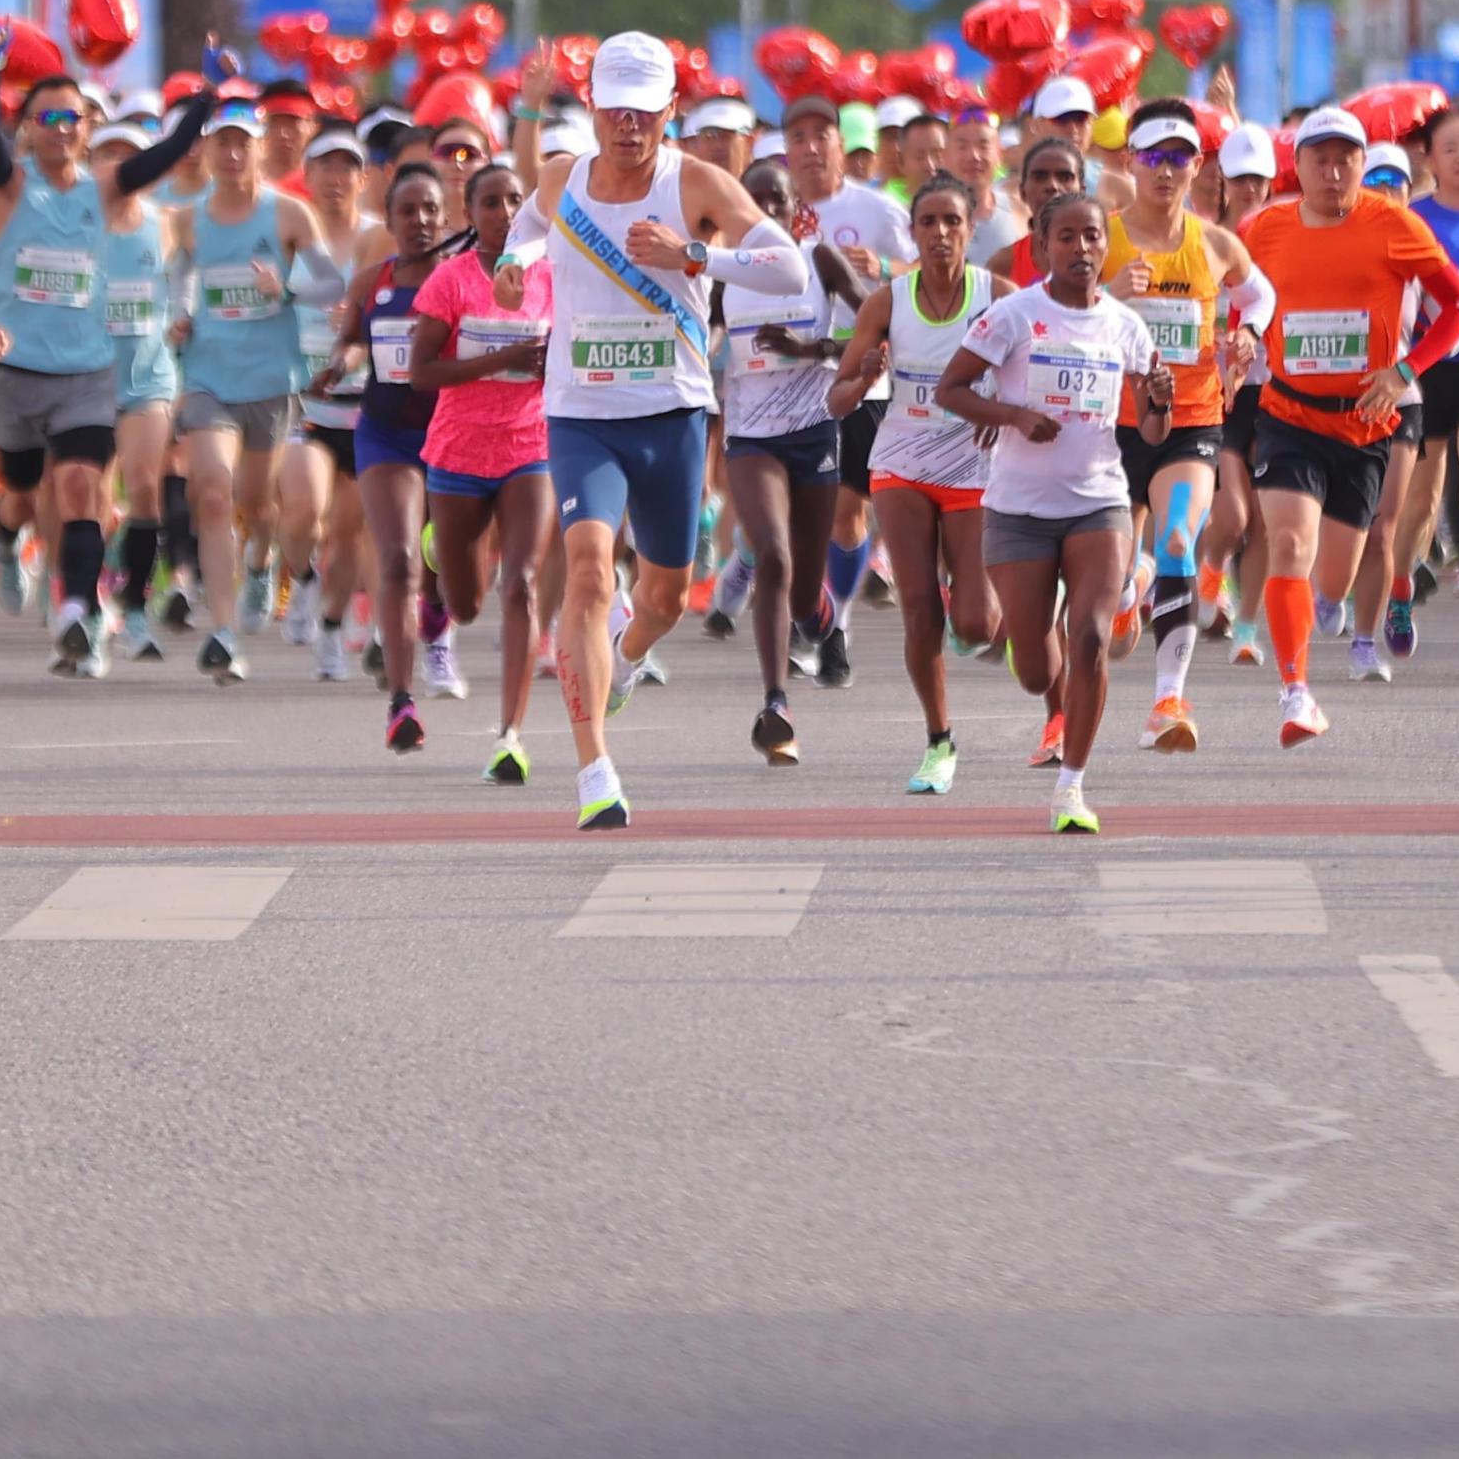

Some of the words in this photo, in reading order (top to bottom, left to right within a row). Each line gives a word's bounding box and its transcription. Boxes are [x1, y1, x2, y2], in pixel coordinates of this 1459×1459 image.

[566, 208, 633, 277] SUNSET
[586, 343, 656, 367] A0643
[1300, 336, 1347, 357] A1917
[1057, 369, 1097, 393] 032
